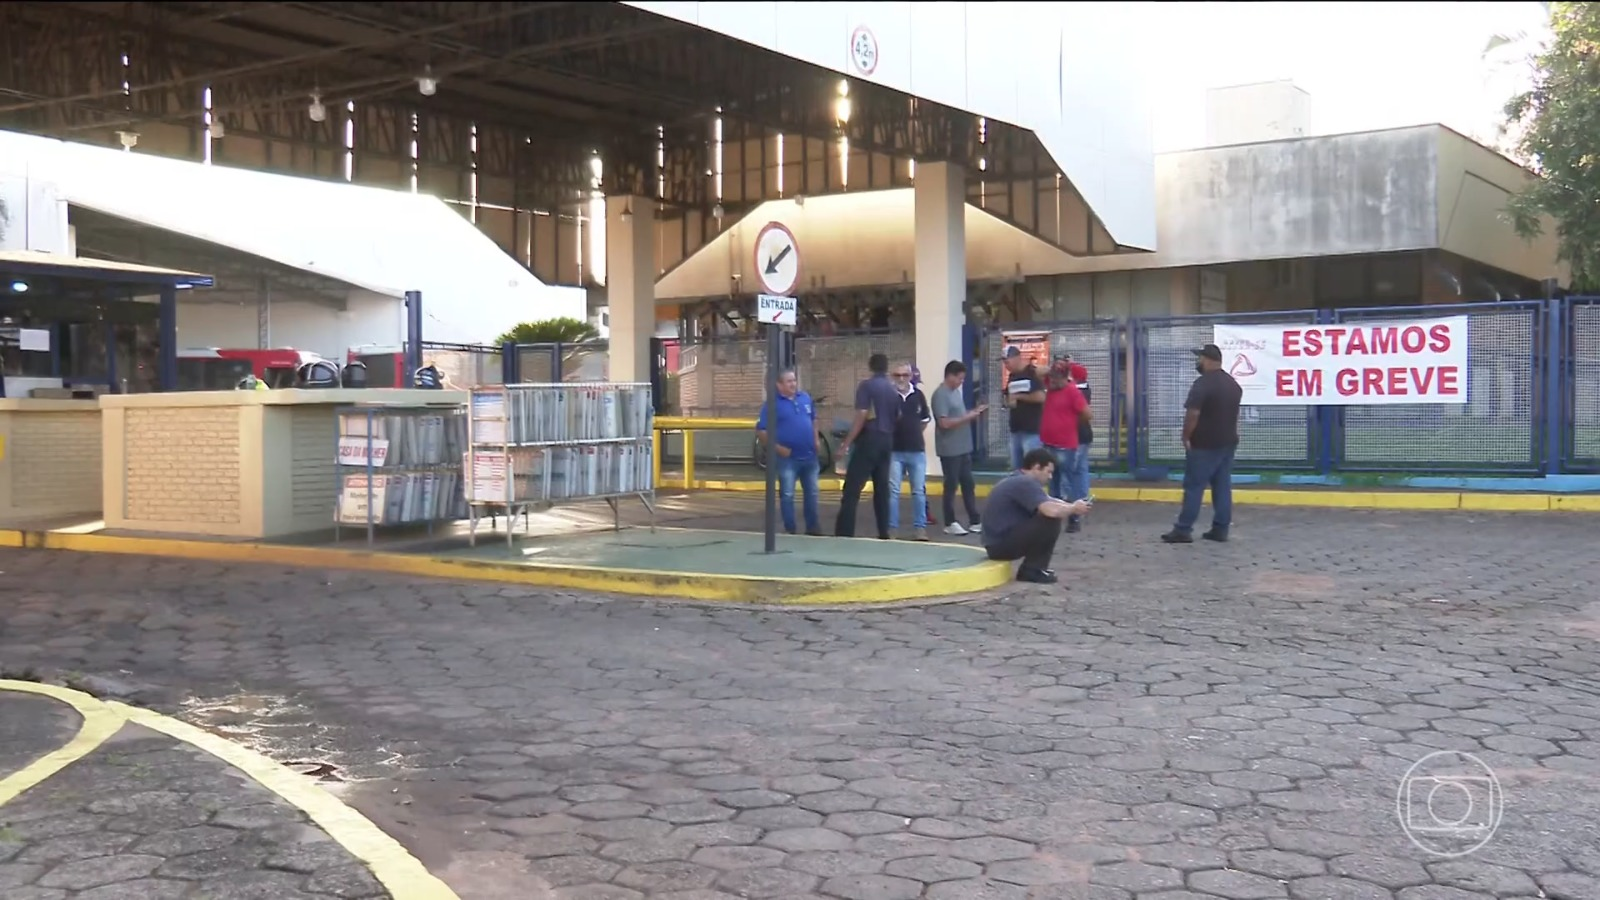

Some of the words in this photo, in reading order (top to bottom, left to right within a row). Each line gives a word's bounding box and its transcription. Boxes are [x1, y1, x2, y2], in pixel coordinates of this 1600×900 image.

[760, 298, 794, 311] ENTRADA
[1282, 324, 1451, 357] ESTAMOS
[1276, 369, 1322, 396] EM
[1335, 366, 1459, 396] GREVE
